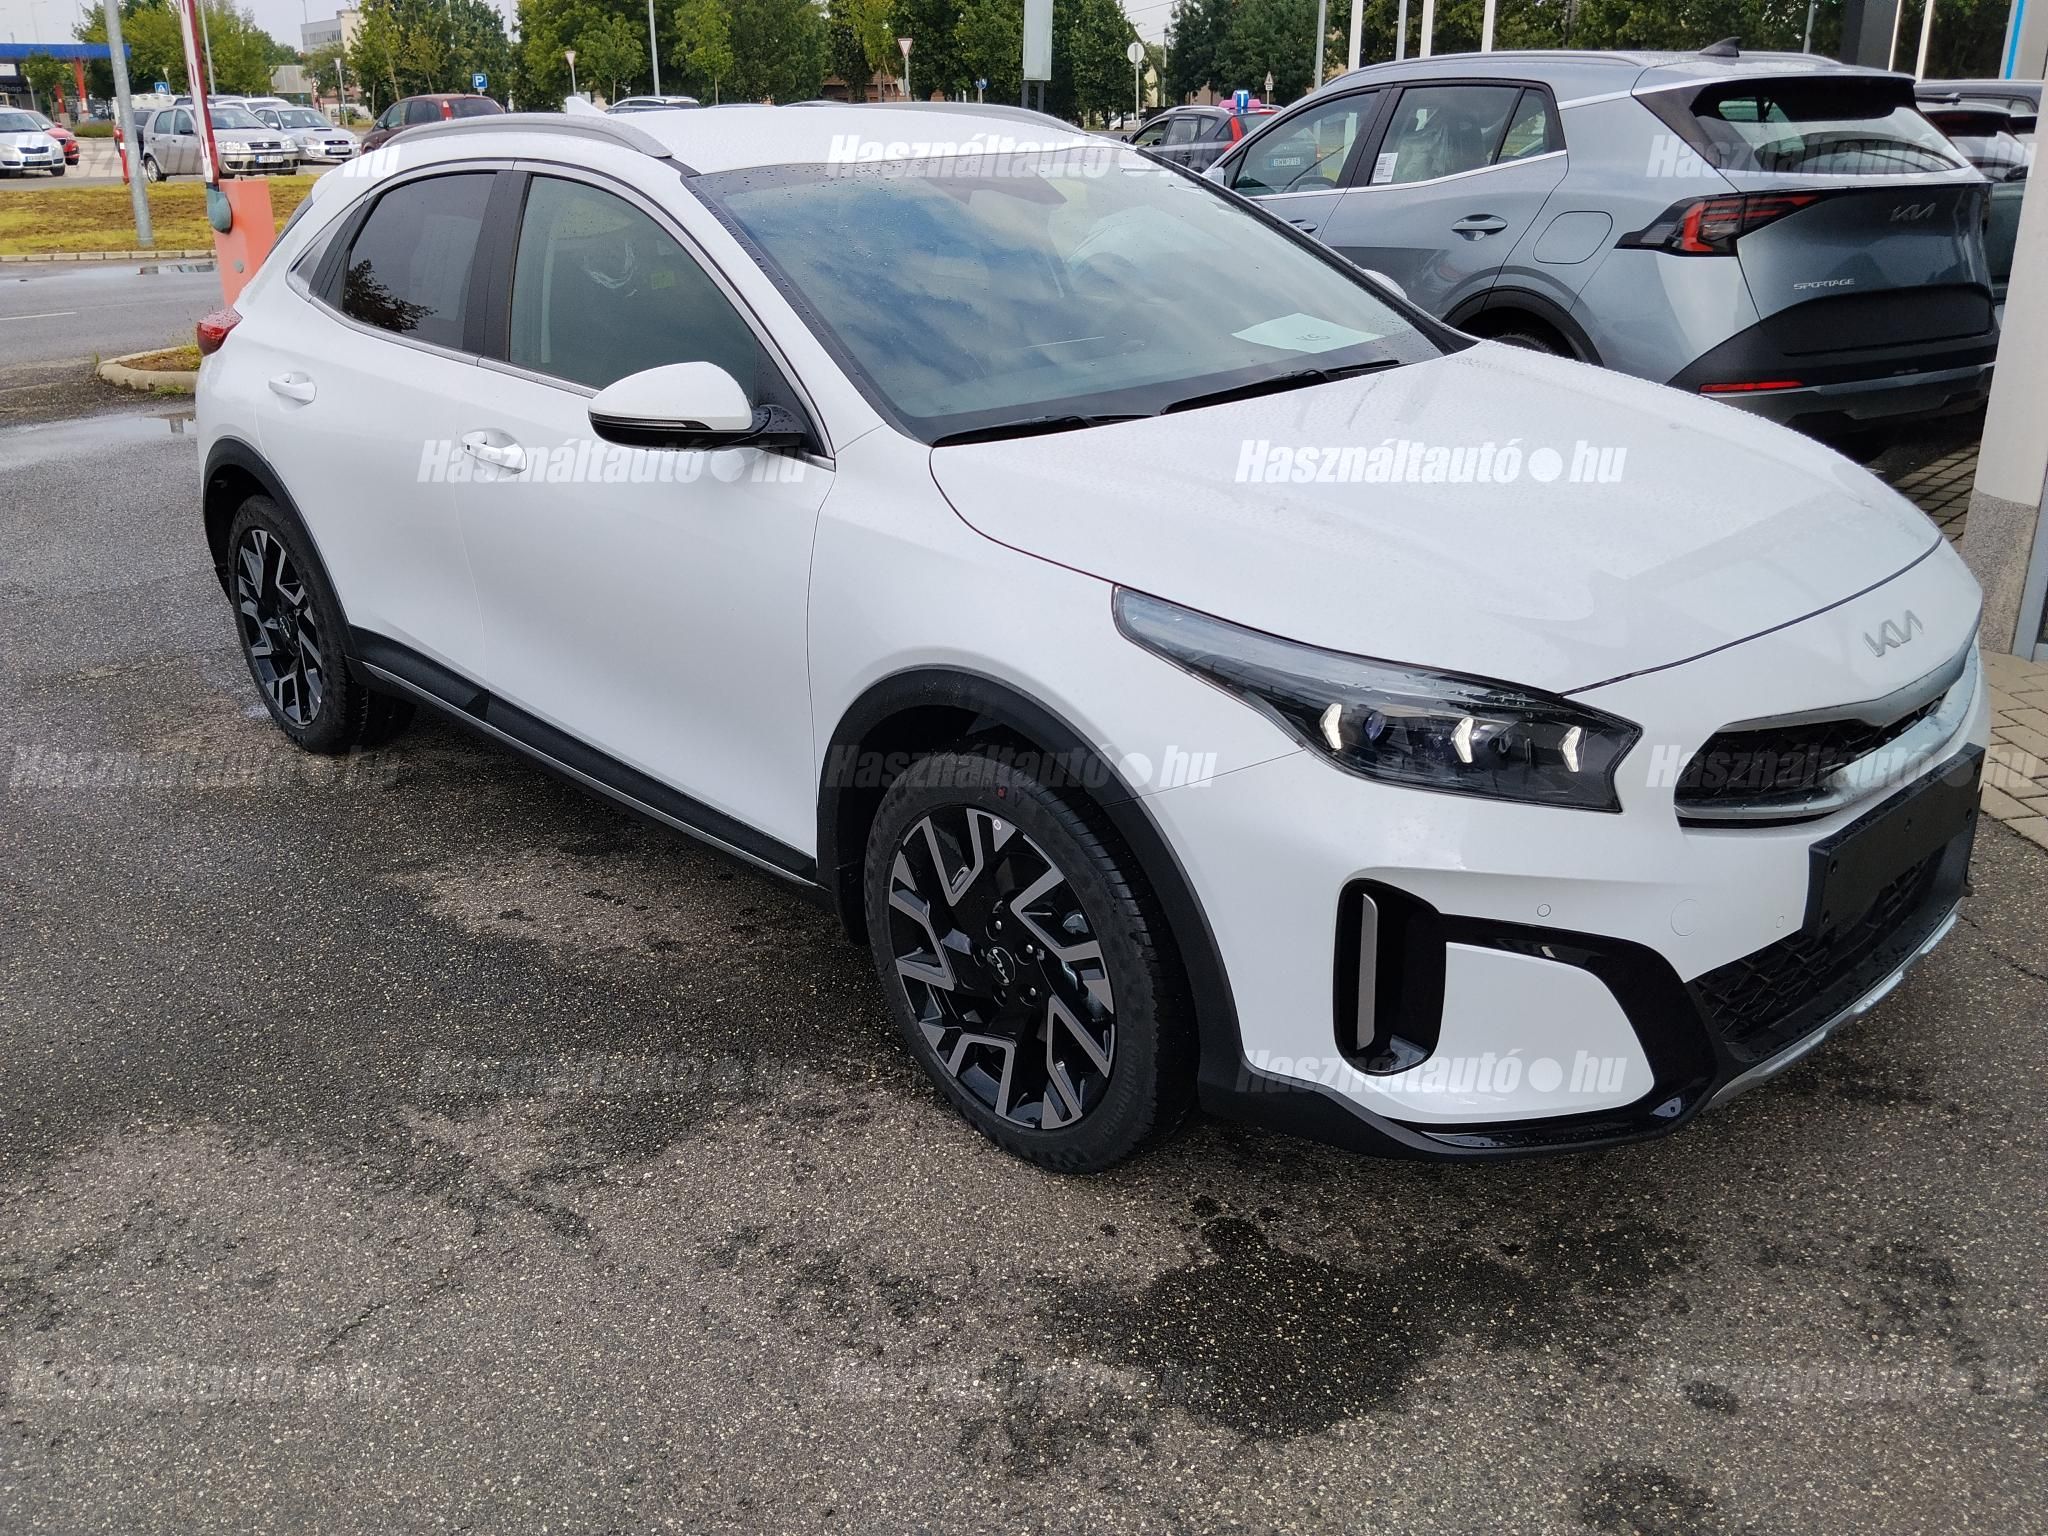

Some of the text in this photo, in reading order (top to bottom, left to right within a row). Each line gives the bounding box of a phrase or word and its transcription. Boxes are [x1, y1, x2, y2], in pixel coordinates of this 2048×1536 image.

[475, 75, 484, 87] P
[1889, 202, 1937, 222] KIA
[1793, 278, 1857, 290] SPORTAGE
[1862, 609, 1924, 658] KIA
